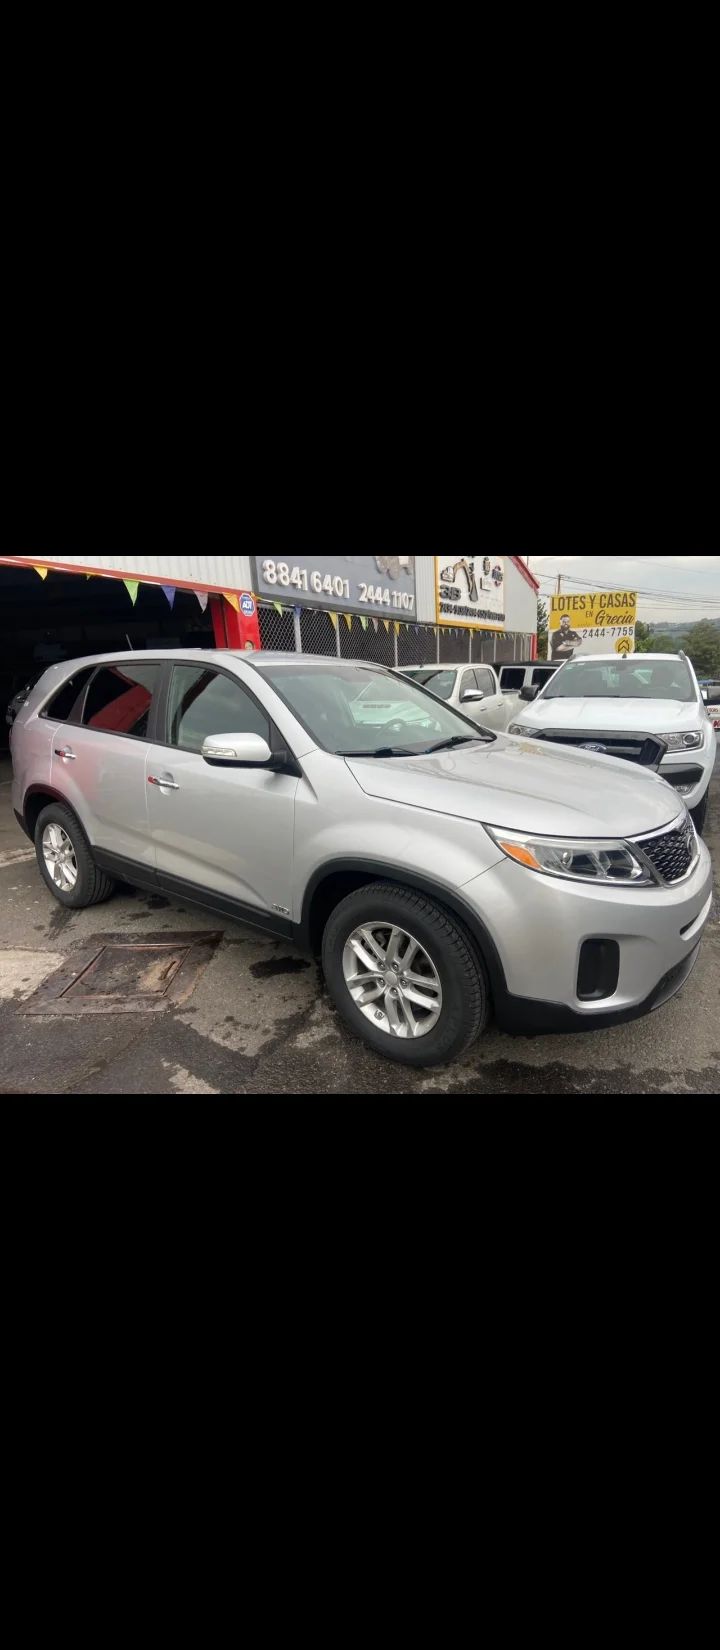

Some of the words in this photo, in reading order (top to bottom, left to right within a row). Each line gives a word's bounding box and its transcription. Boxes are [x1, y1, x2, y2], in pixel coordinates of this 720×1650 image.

[262, 559, 308, 591] 8841
[310, 571, 350, 599] 6401
[358, 583, 390, 606] 2444
[391, 590, 415, 611] 1107
[551, 595, 586, 611] LOTES
[589, 595, 597, 609] Y
[599, 592, 636, 609] CASAS
[586, 610, 593, 618] EN
[595, 610, 634, 625] Grecia
[582, 627, 634, 638] 2444-7755
